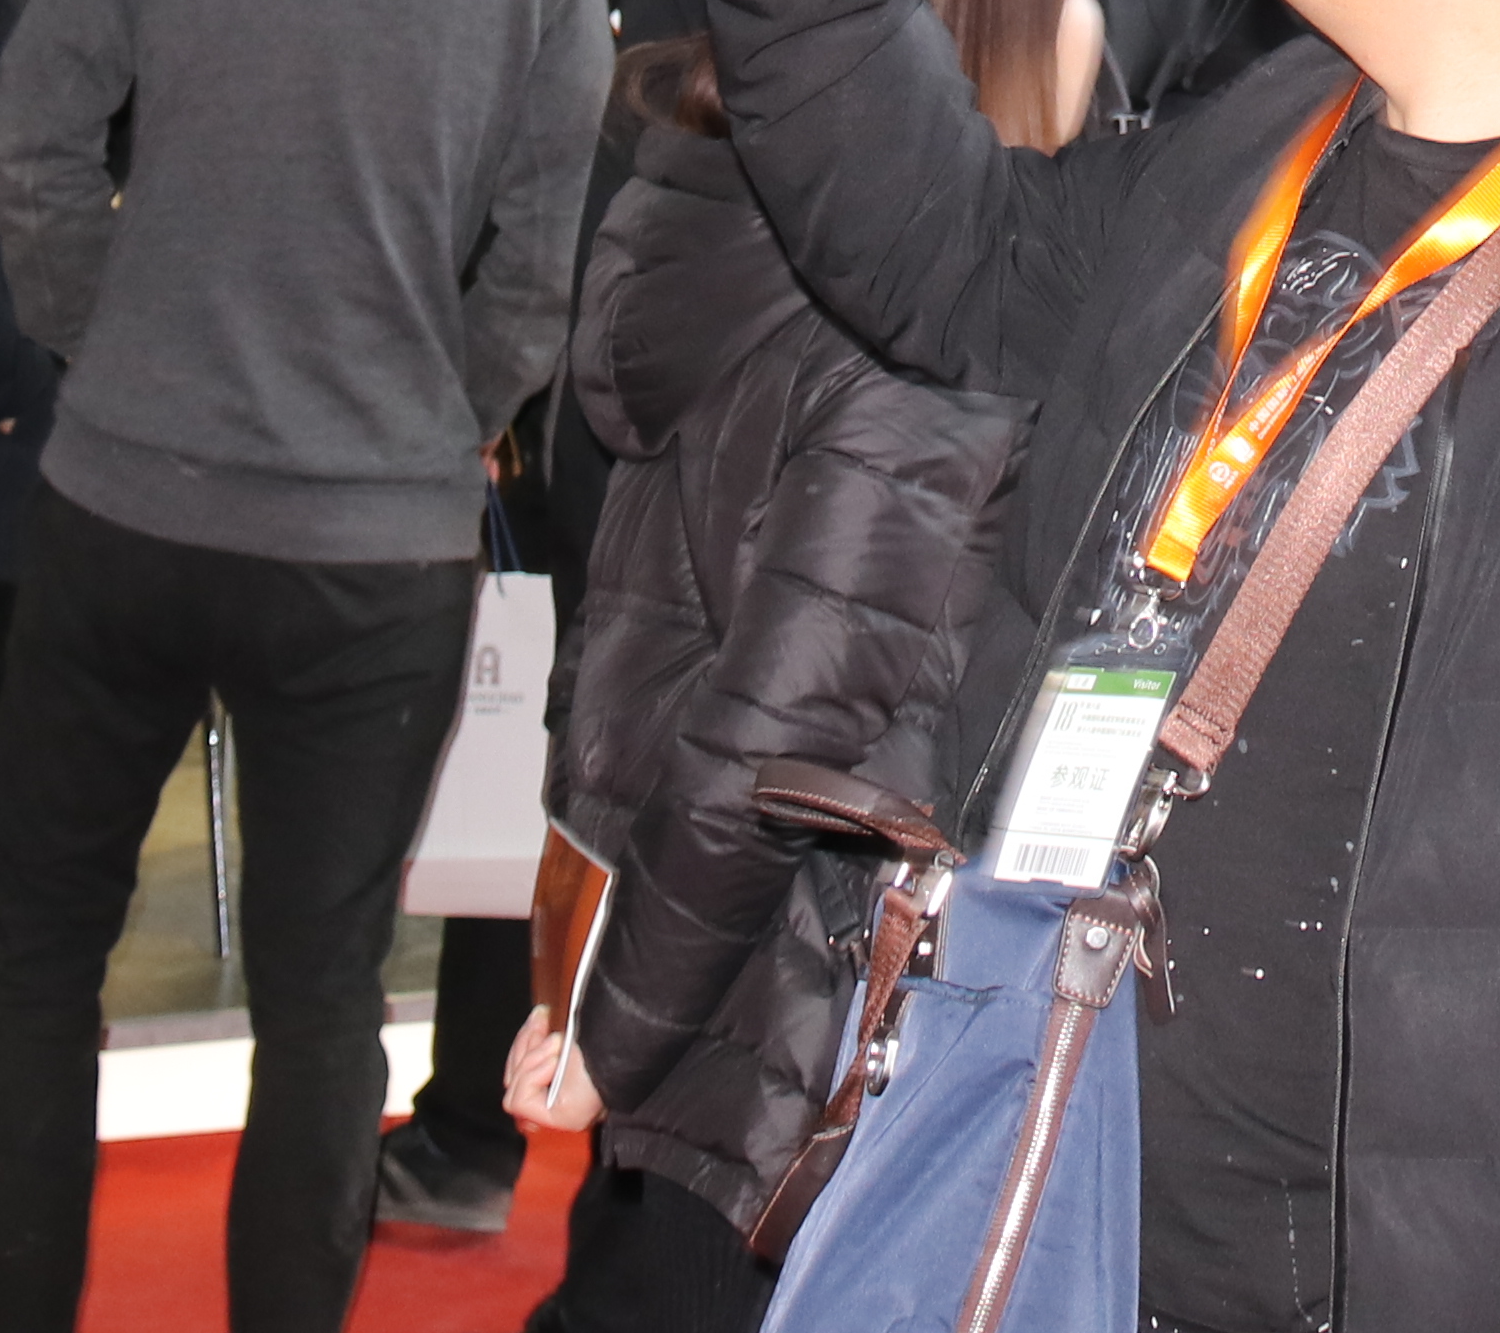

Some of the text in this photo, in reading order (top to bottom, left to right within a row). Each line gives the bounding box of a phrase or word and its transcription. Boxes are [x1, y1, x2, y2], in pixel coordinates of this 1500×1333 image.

[1133, 677, 1162, 691] Visitor
[1050, 764, 1110, 791] 参观证
